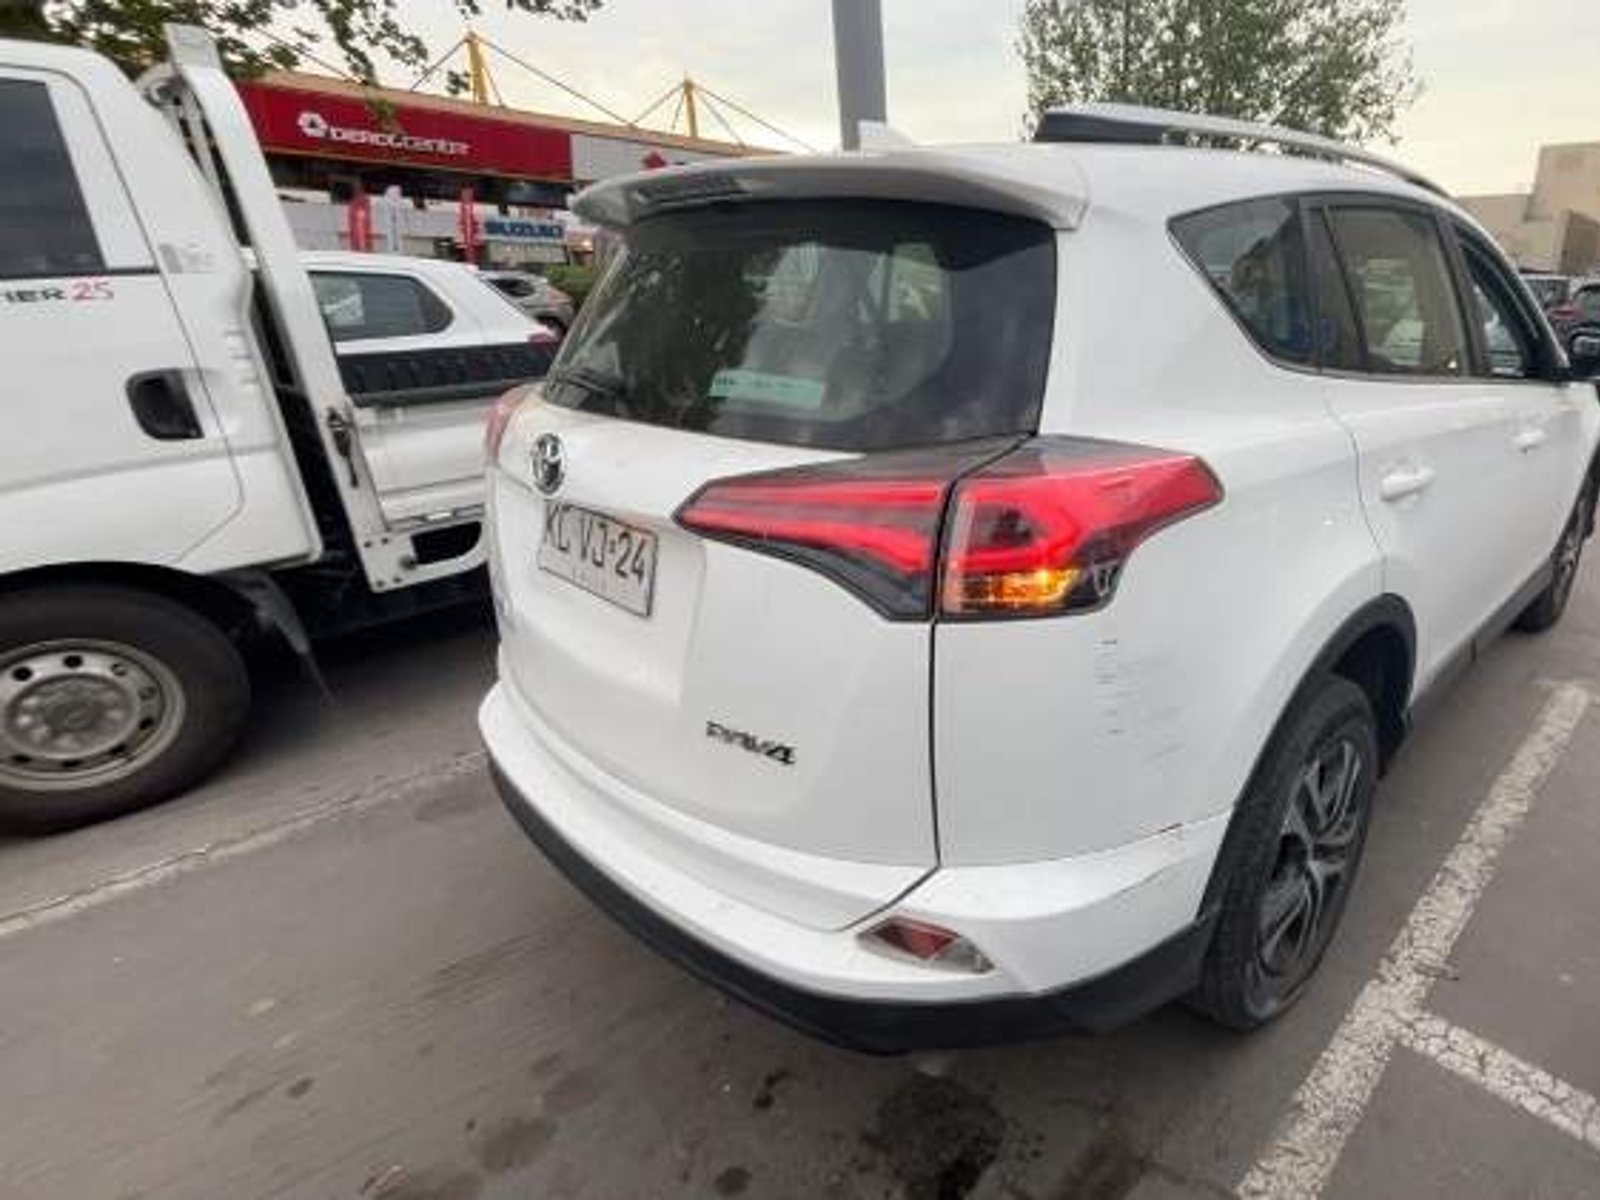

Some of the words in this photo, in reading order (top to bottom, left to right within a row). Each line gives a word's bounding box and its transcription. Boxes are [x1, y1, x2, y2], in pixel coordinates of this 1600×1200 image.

[72, 281, 115, 302] 25
[544, 501, 571, 552] KL
[706, 720, 798, 765] RAV4
